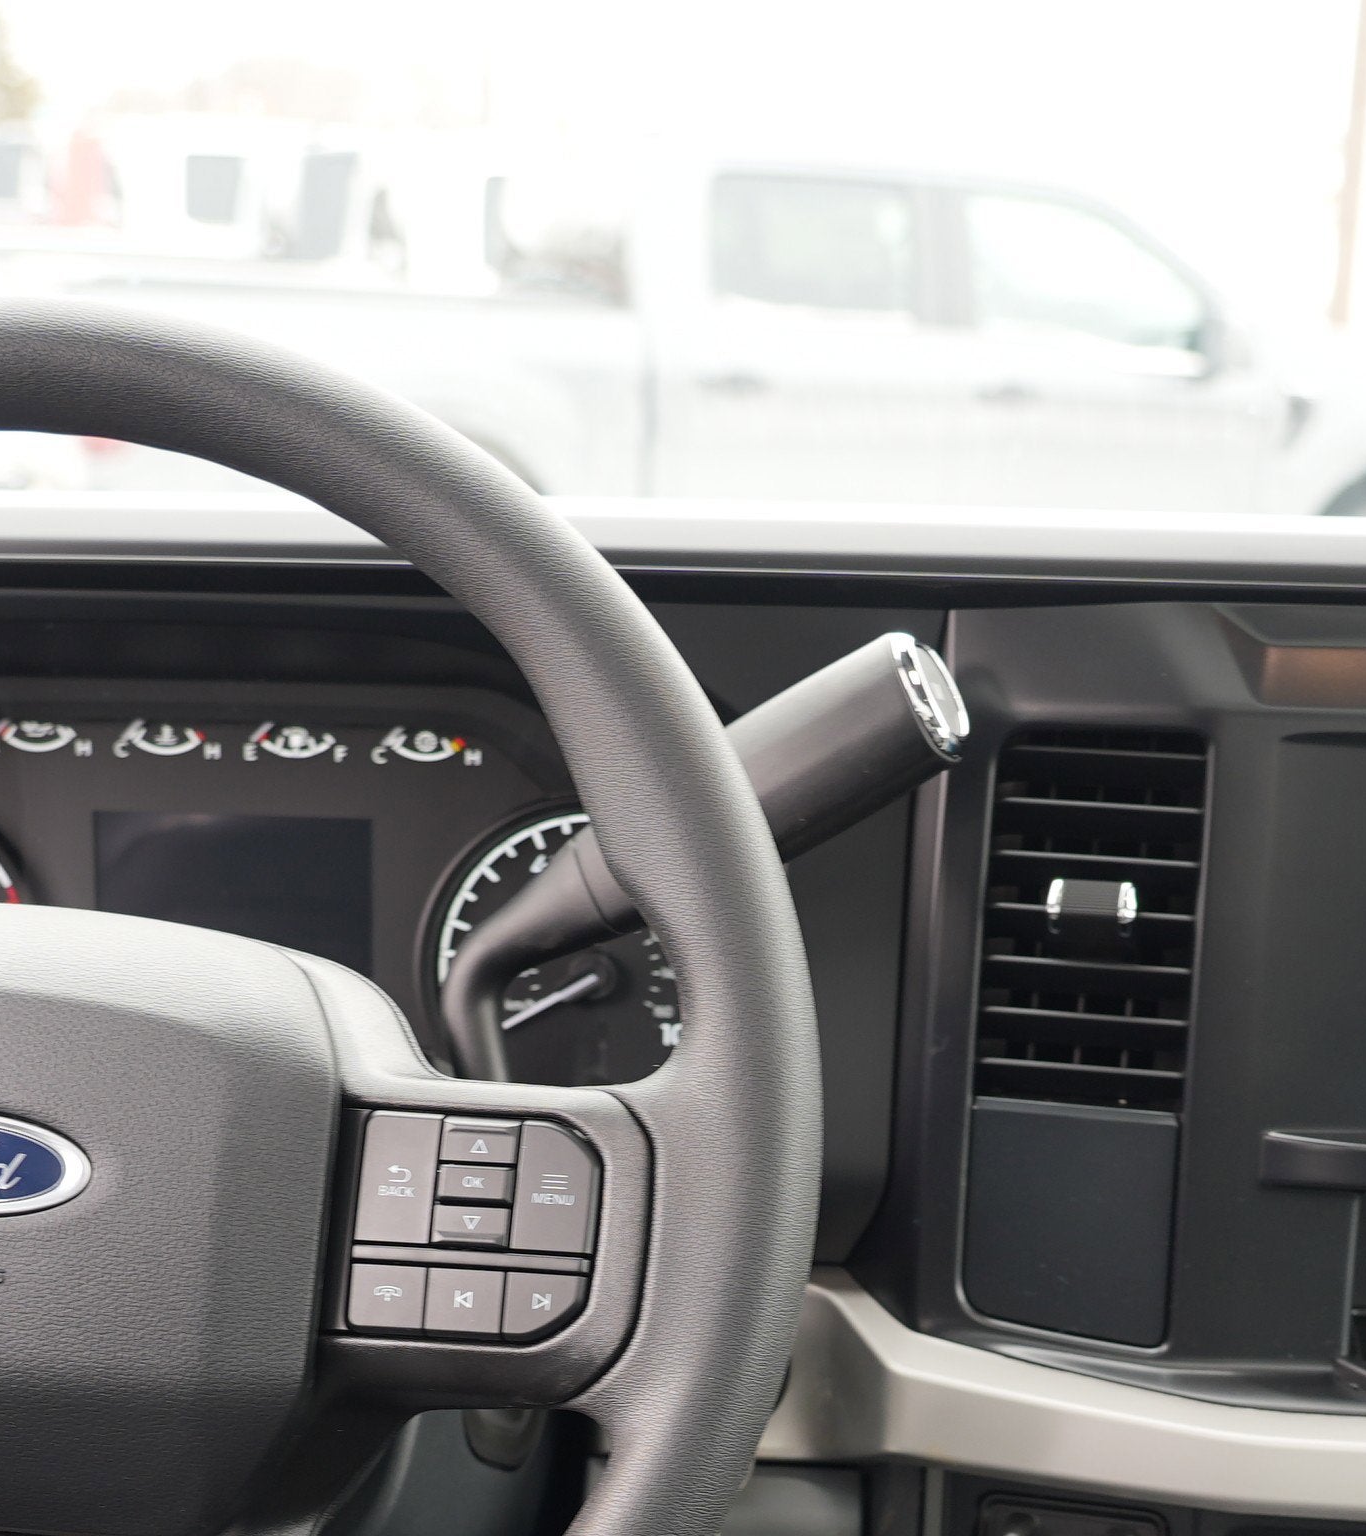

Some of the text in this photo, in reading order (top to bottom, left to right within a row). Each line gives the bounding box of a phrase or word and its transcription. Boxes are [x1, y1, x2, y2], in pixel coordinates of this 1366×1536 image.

[74, 740, 92, 757] H
[113, 740, 131, 758] C
[204, 743, 221, 760] H
[243, 743, 258, 761] E
[371, 747, 388, 764] C
[464, 749, 482, 767] H
[461, 1176, 486, 1189] OK
[377, 1185, 416, 1198] BACK
[531, 1193, 576, 1206] MENU
